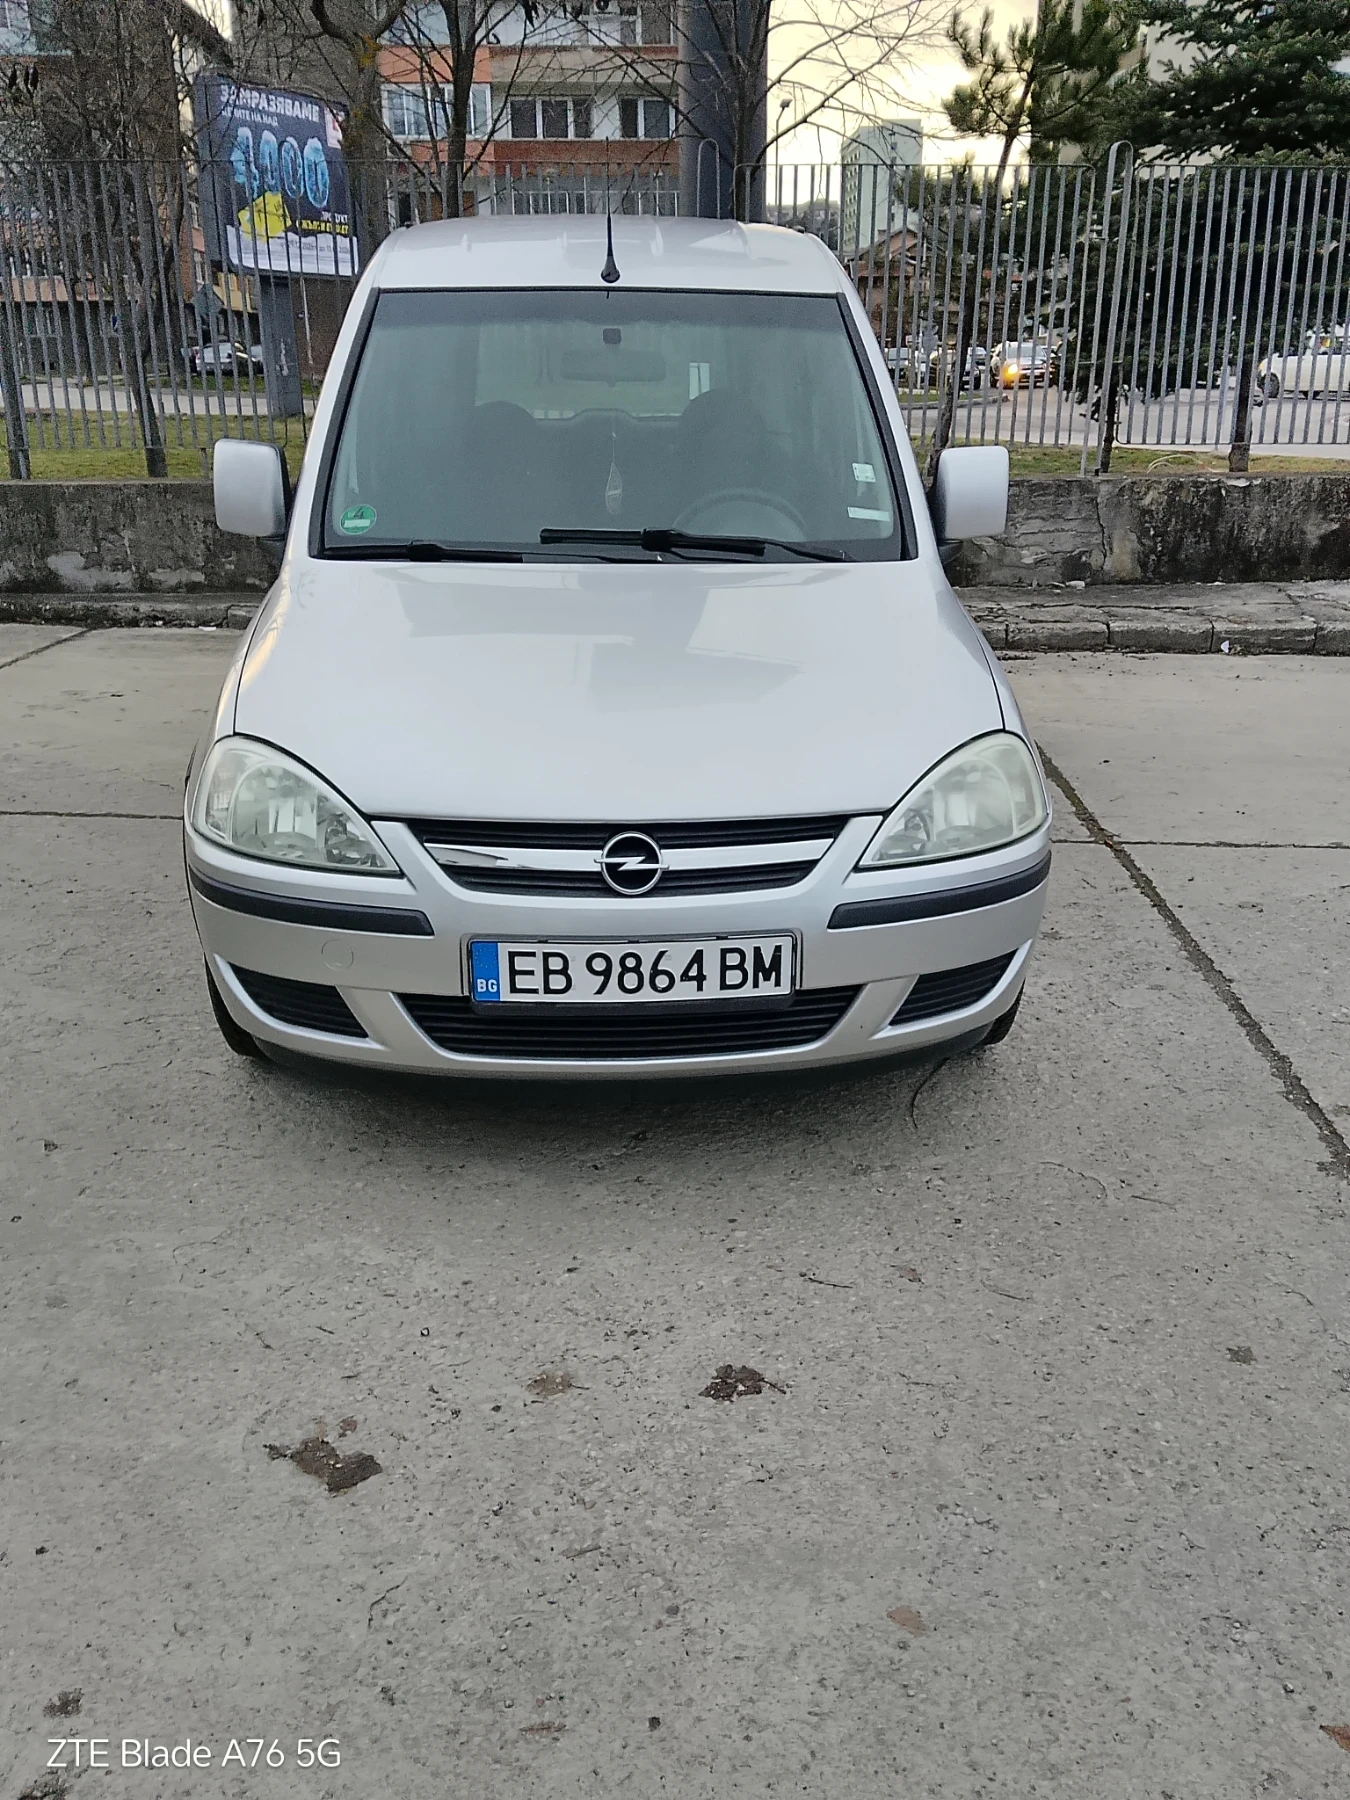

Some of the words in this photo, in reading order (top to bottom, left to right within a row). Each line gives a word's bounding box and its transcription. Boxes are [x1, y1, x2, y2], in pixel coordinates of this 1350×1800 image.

[220, 85, 319, 122] ЗАМРАЗЯВАМЕ
[476, 980, 498, 993] BG
[507, 949, 573, 995] EB
[585, 948, 707, 995] 9864
[719, 944, 783, 991] BM
